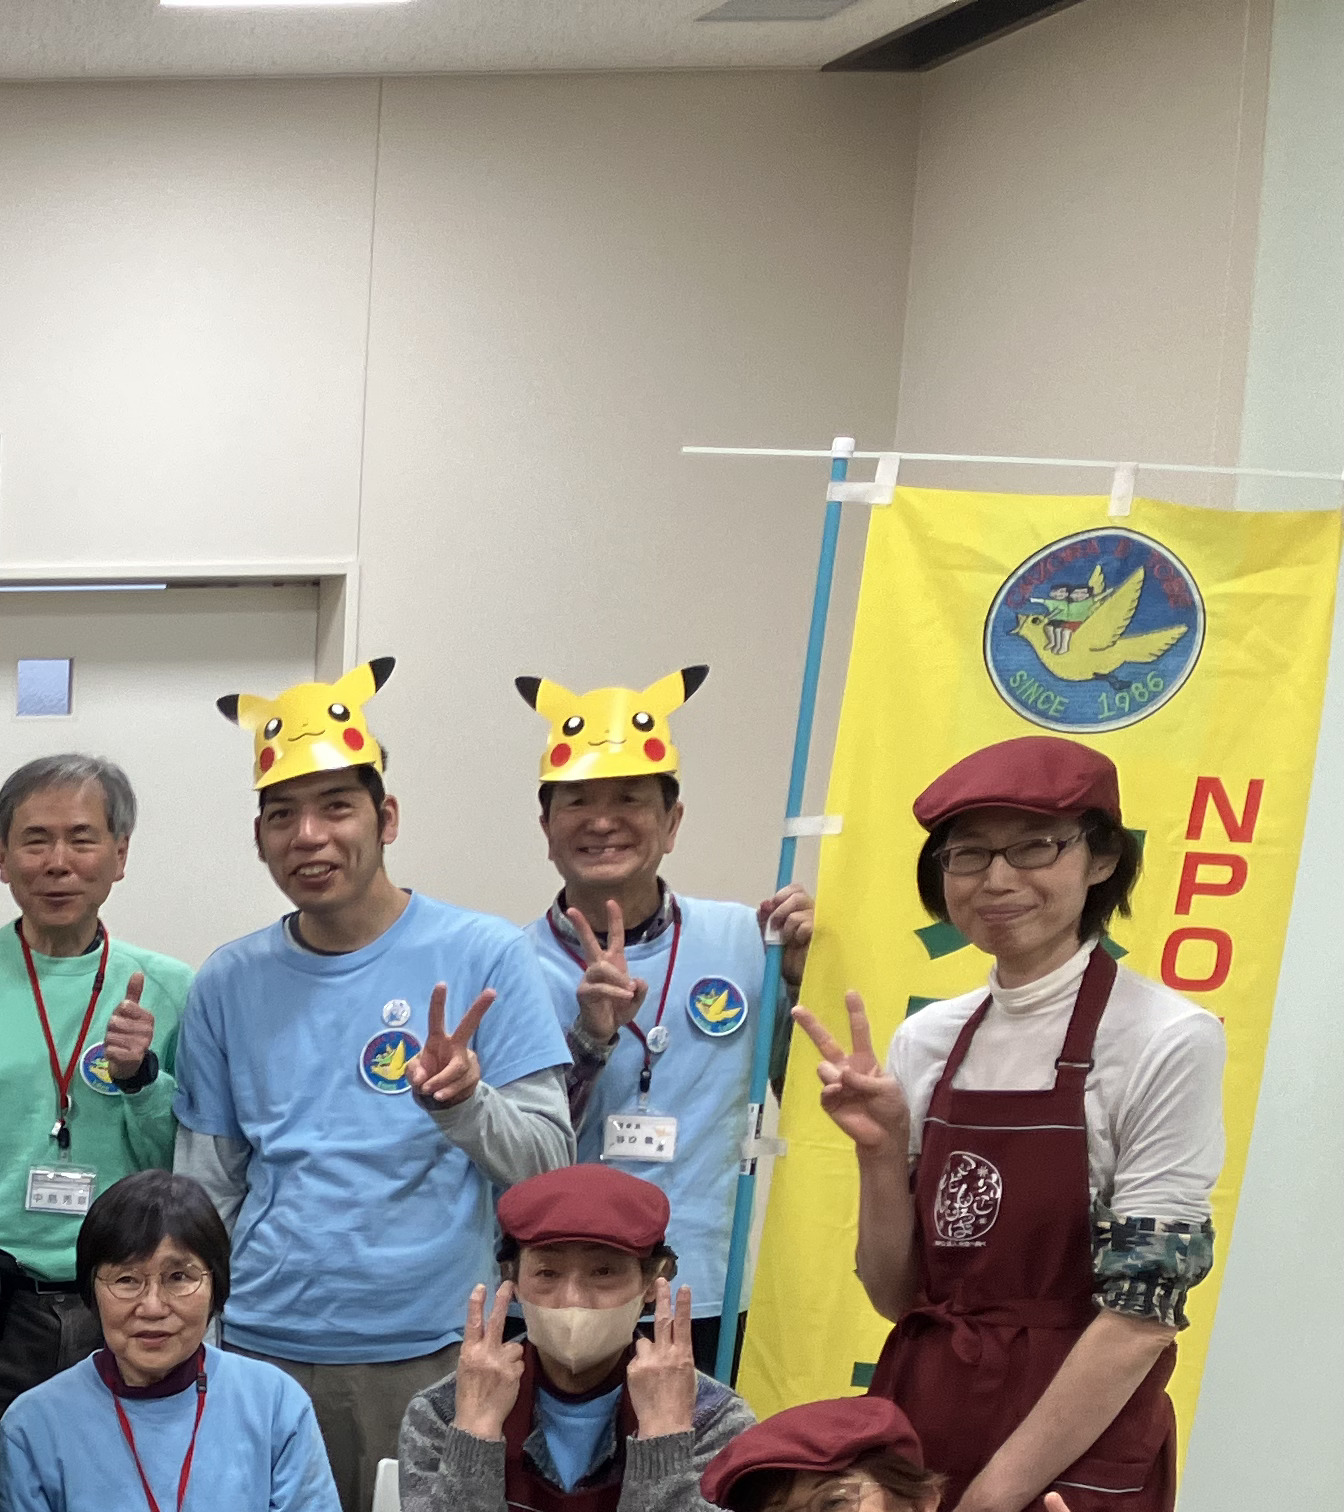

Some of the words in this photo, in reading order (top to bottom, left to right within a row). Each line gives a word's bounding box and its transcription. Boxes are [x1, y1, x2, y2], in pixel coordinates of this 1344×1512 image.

[1009, 670, 1069, 717] SINCE
[1097, 671, 1164, 719] 1986
[1160, 776, 1265, 992] NPO
